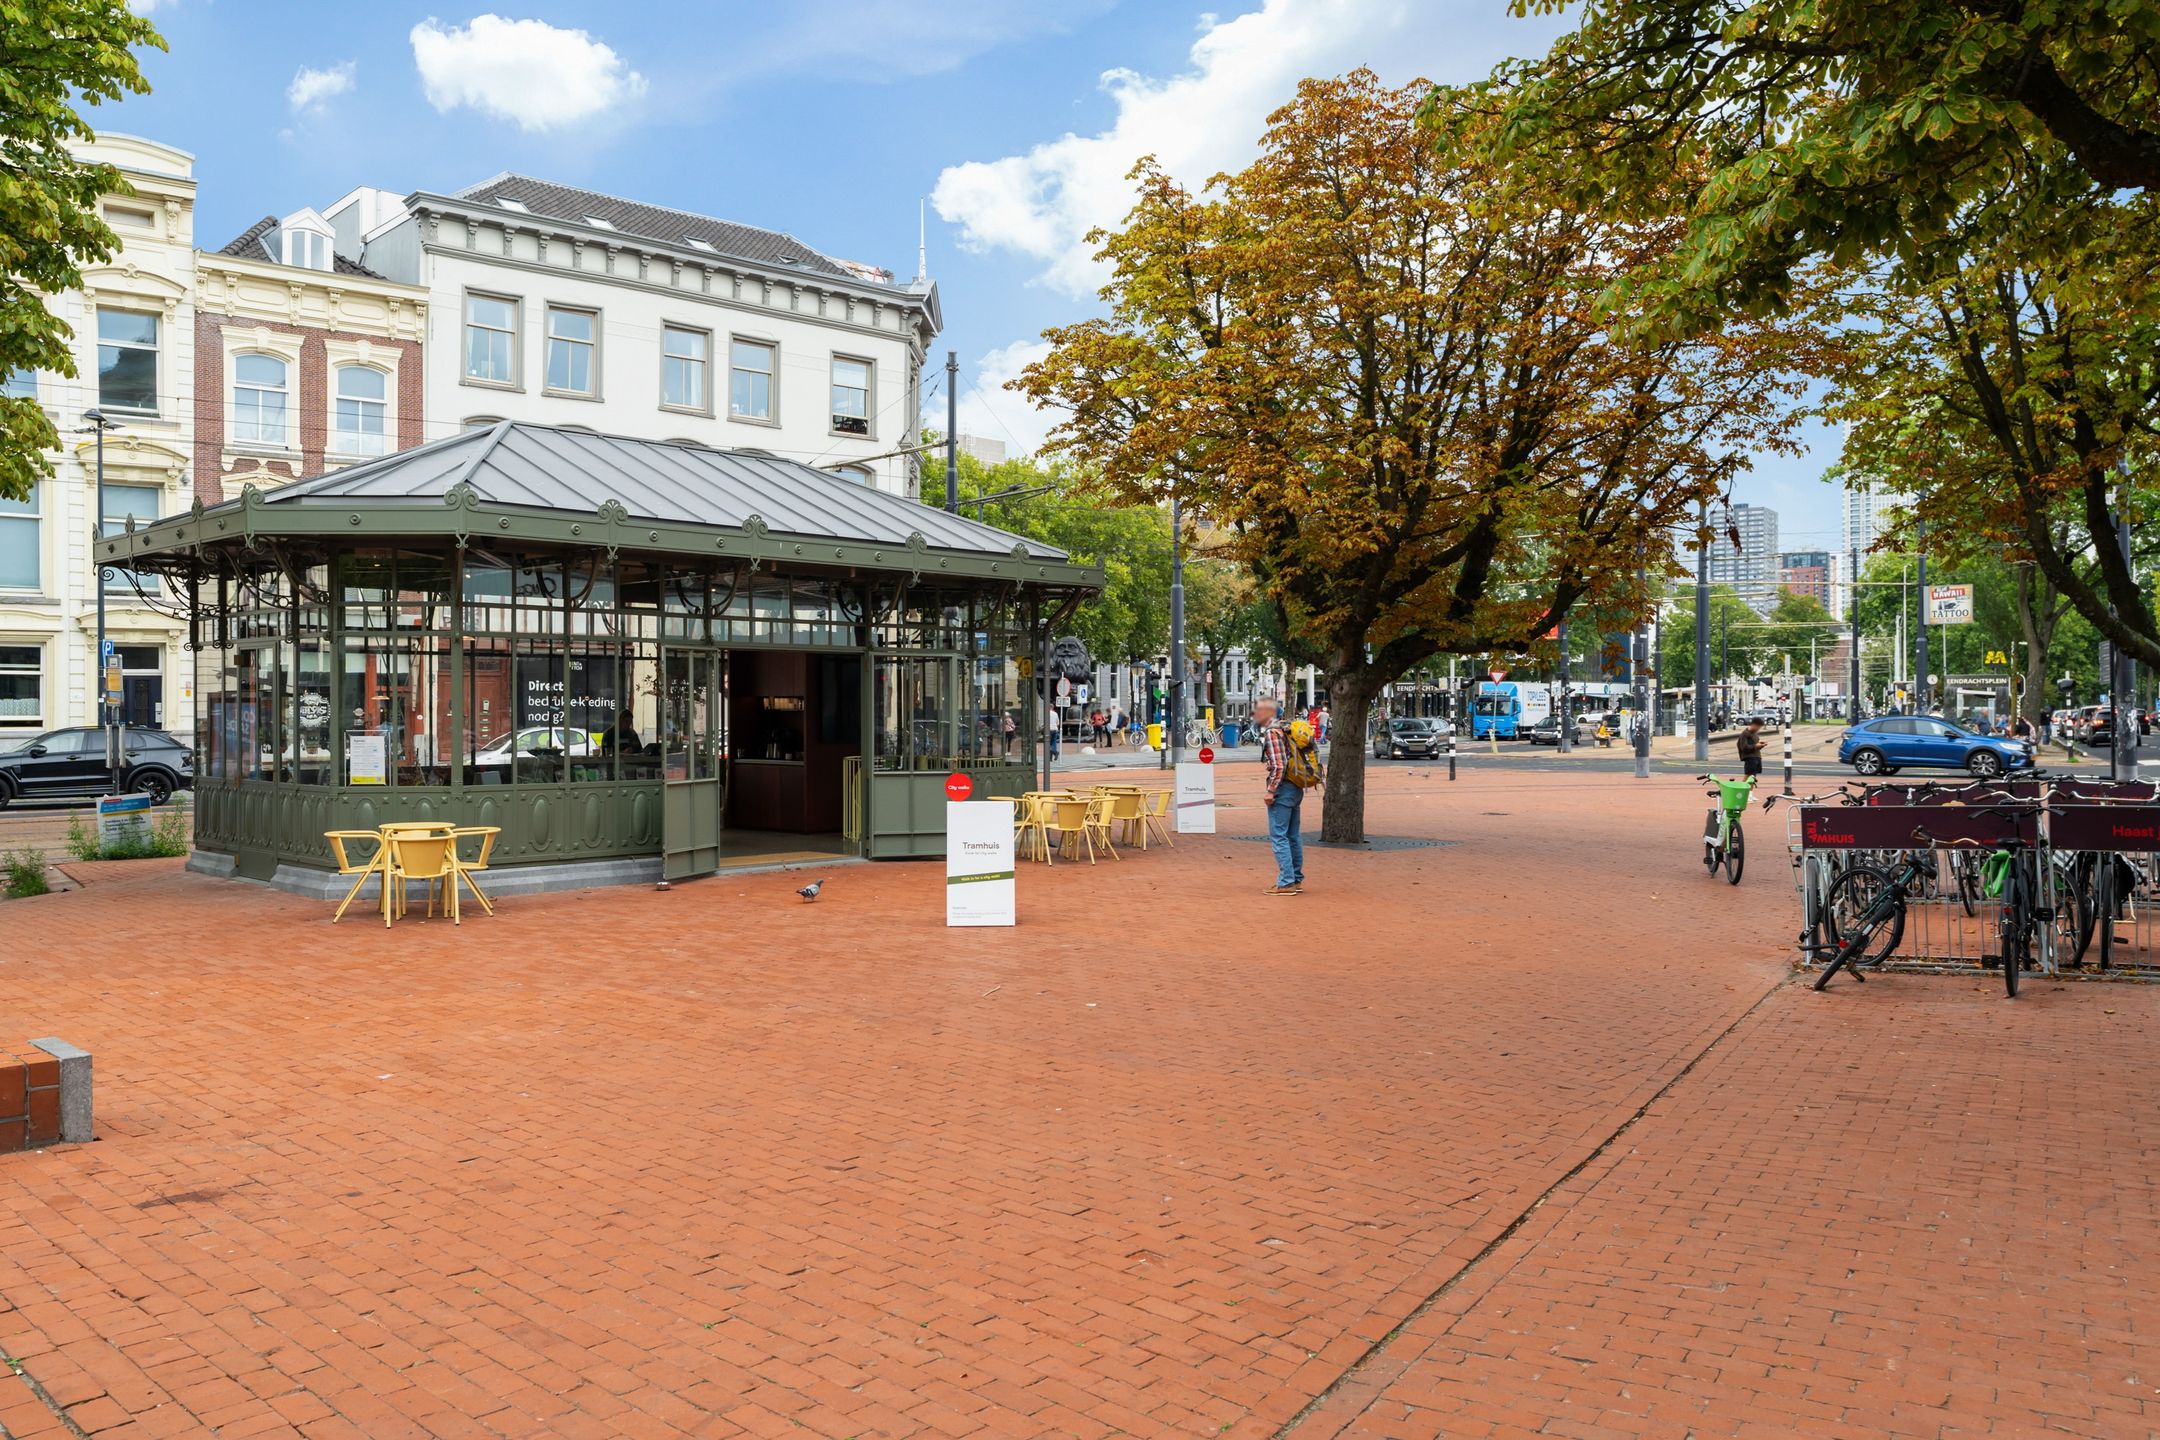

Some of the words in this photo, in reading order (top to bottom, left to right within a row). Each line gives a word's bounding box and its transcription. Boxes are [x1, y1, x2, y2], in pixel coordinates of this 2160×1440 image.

[105, 642, 112, 655] P
[528, 711, 565, 725] nodg?
[2112, 825, 2154, 838] Haast
[962, 842, 1000, 850] Tramhuis
